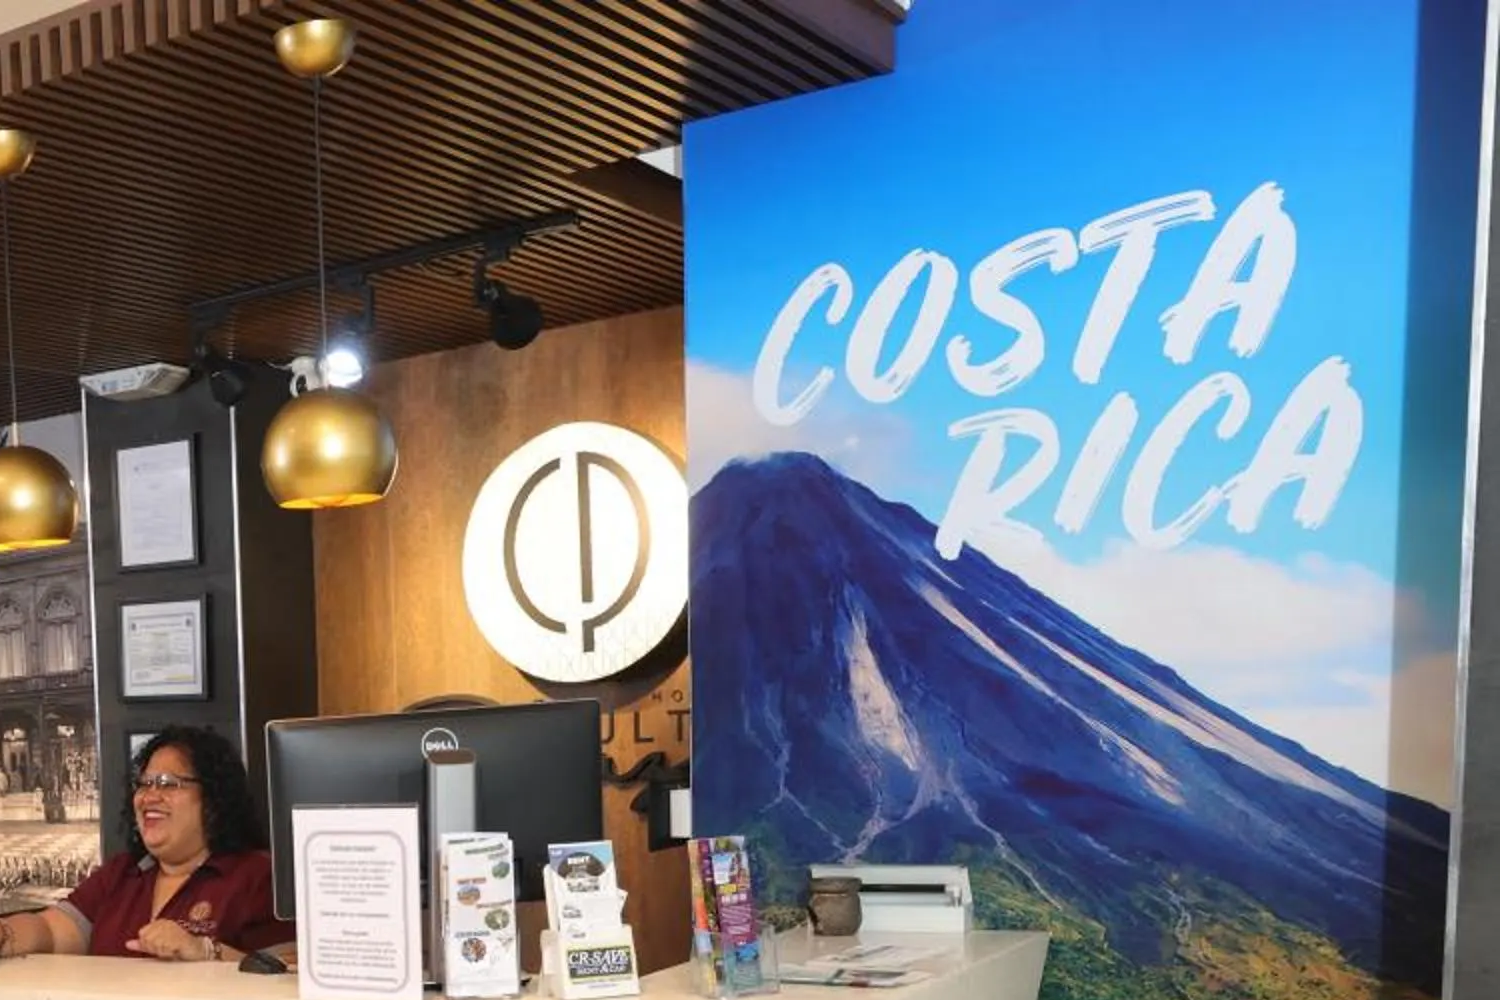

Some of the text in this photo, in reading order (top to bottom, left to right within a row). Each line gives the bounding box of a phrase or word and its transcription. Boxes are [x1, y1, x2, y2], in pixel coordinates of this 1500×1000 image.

[754, 181, 1297, 426] COSTA
[935, 355, 1363, 561] RICA
[425, 739, 455, 751] DELL
